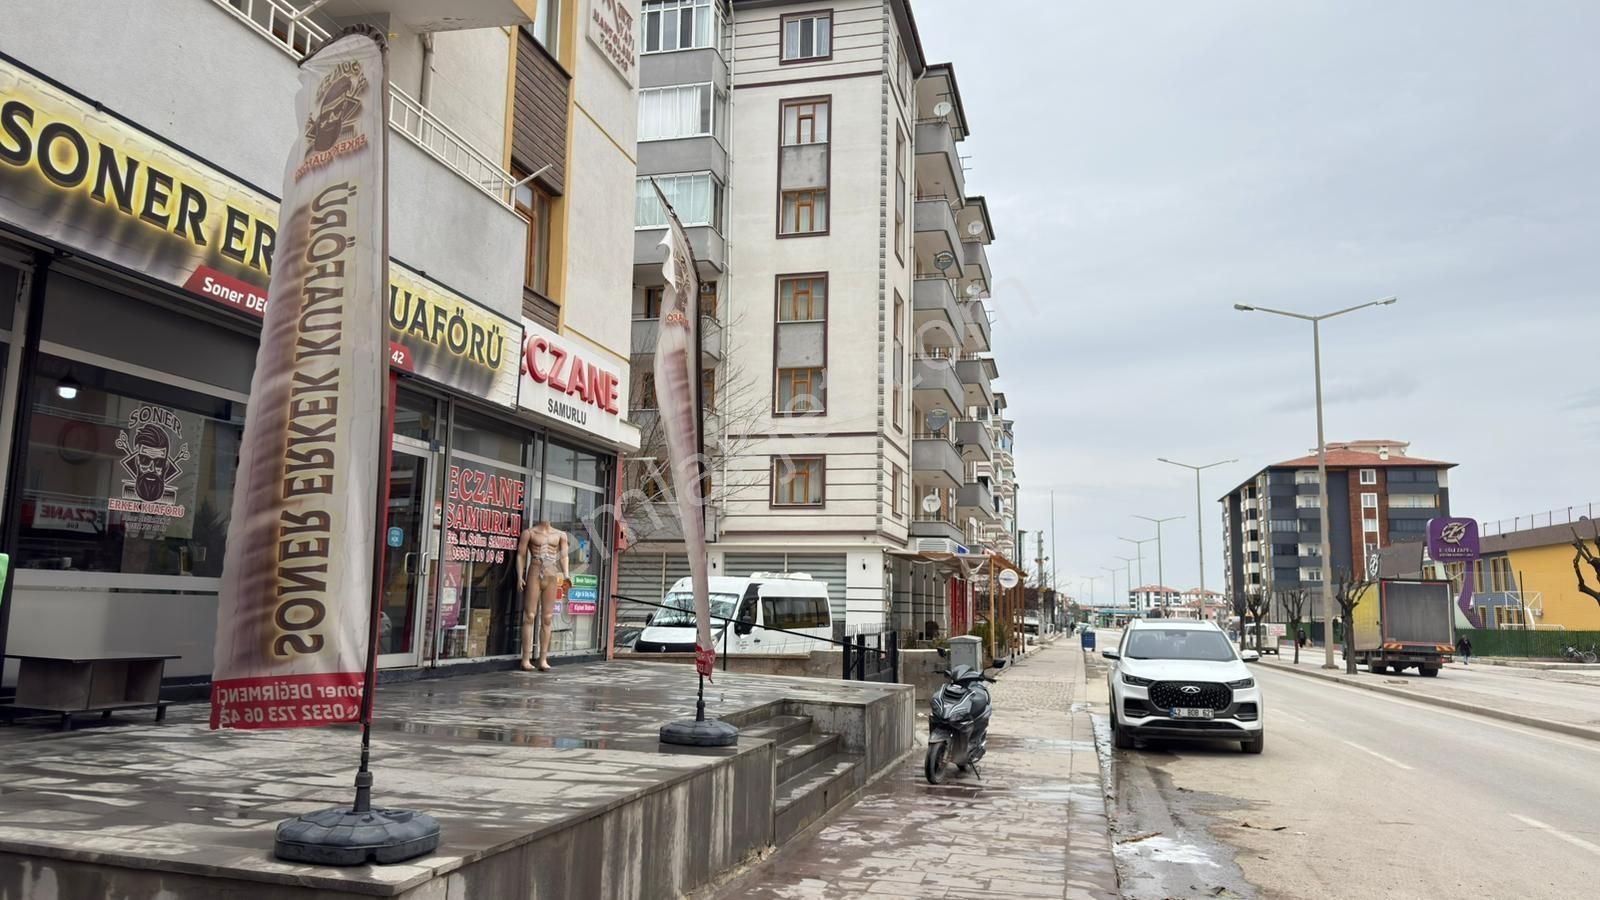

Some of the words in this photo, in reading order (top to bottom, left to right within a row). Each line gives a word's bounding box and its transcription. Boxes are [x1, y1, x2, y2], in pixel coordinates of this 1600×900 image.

[0, 101, 208, 246] SONER
[203, 276, 245, 304] Soner
[391, 350, 404, 365] 42
[521, 331, 619, 416] CZANE
[128, 406, 183, 440] SONER
[547, 398, 587, 425] SAMURLU
[108, 498, 140, 512] ERKEK
[449, 466, 524, 510] ECZANE
[446, 502, 521, 537] SAMURLU
